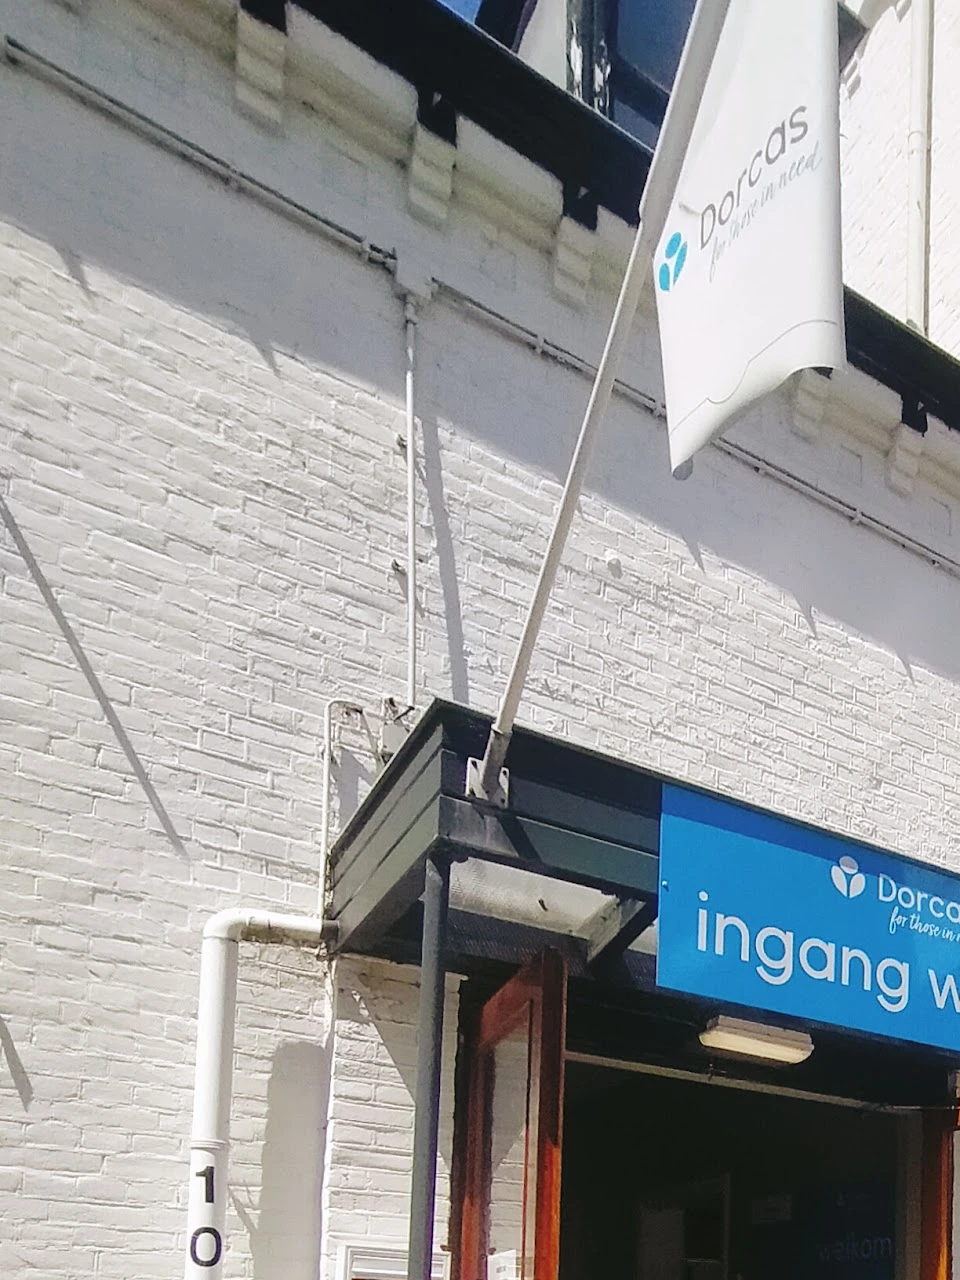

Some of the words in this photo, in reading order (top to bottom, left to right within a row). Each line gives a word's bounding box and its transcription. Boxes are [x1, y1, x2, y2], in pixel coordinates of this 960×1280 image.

[700, 105, 809, 251] Dorcas
[727, 201, 759, 246] those
[760, 184, 777, 208] in
[778, 140, 823, 189] need
[697, 890, 910, 1013] ingang
[889, 906, 908, 935] for
[909, 913, 941, 937] those
[942, 926, 956, 942] in
